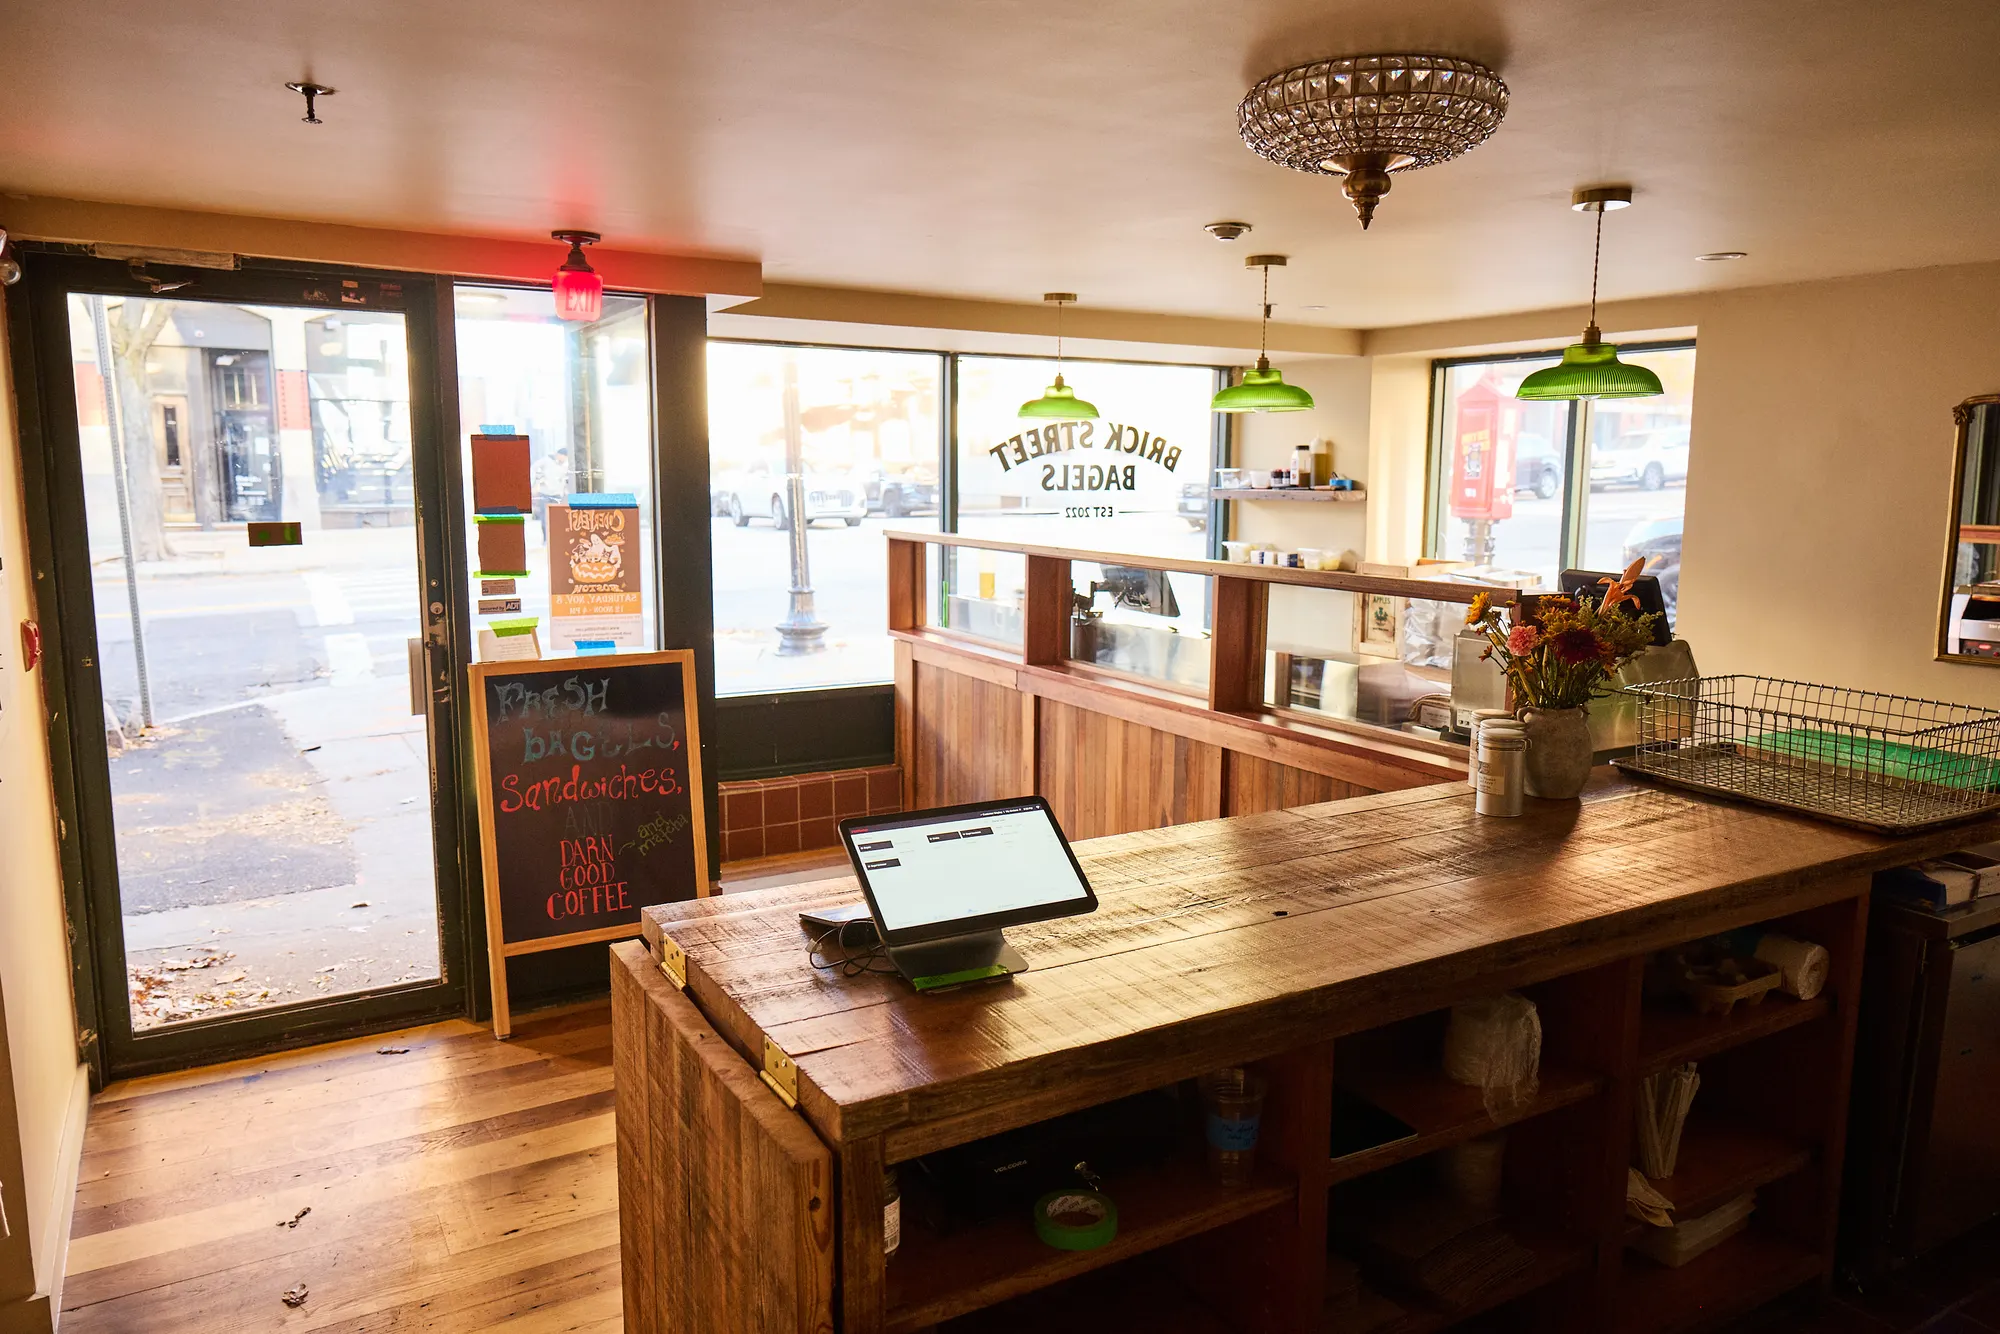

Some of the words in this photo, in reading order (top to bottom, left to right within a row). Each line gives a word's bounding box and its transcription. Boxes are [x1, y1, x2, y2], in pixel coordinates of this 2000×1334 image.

[565, 287, 595, 312] EXIT
[506, 602, 520, 610] ADT
[1373, 596, 1391, 605] APPLES
[494, 675, 611, 725] FRESH
[637, 811, 671, 839] and
[560, 834, 615, 867] DARN
[559, 862, 615, 890] GOOD
[547, 882, 632, 920] COFFEE
[993, 1159, 1029, 1174] VOLCORA
